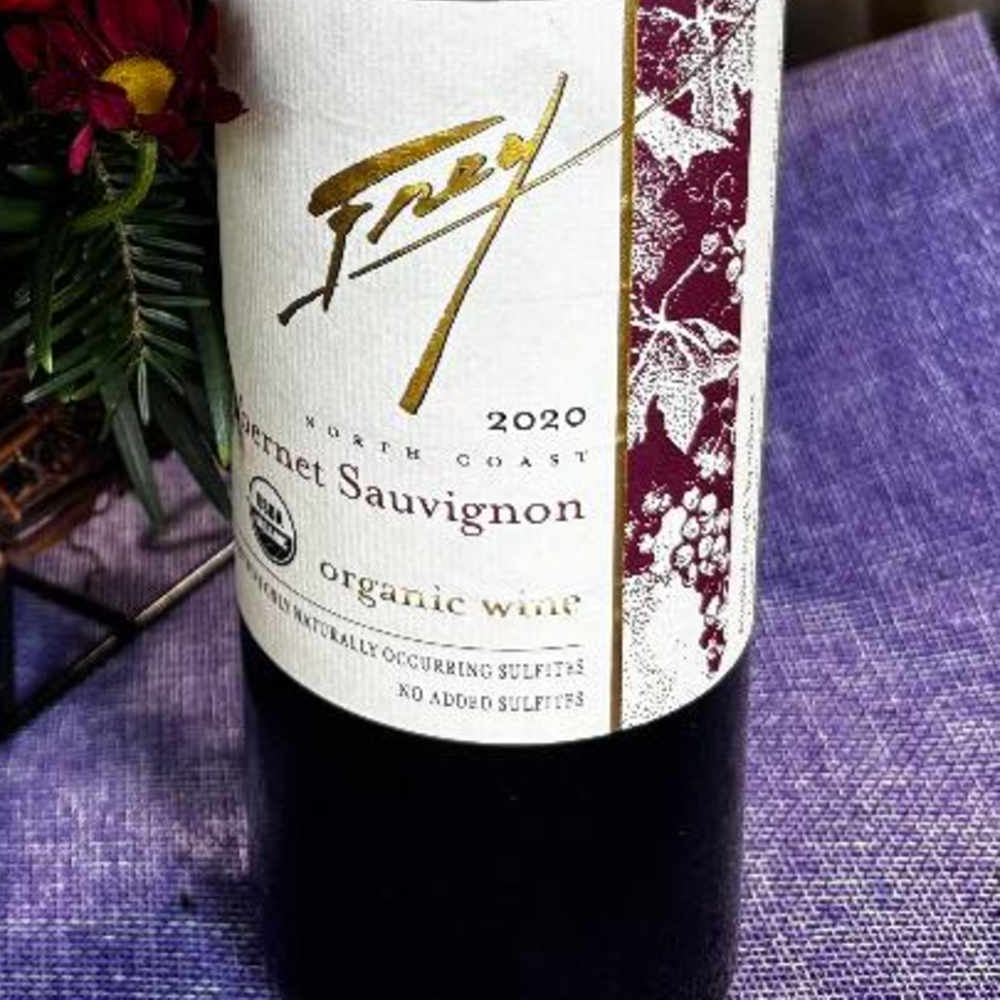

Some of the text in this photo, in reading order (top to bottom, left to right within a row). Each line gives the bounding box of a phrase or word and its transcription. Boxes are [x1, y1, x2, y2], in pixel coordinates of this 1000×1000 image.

[277, 71, 568, 416] Frey
[304, 414, 588, 468] NORTH COAST
[486, 406, 587, 434] 2020
[339, 463, 585, 537] Sauvignon
[319, 560, 582, 618] organic wine
[293, 604, 378, 659] NATURALLY
[382, 646, 493, 680] OCCURRING
[497, 658, 585, 680] SULFITES
[398, 683, 585, 712] NO ADDED SULFITES
